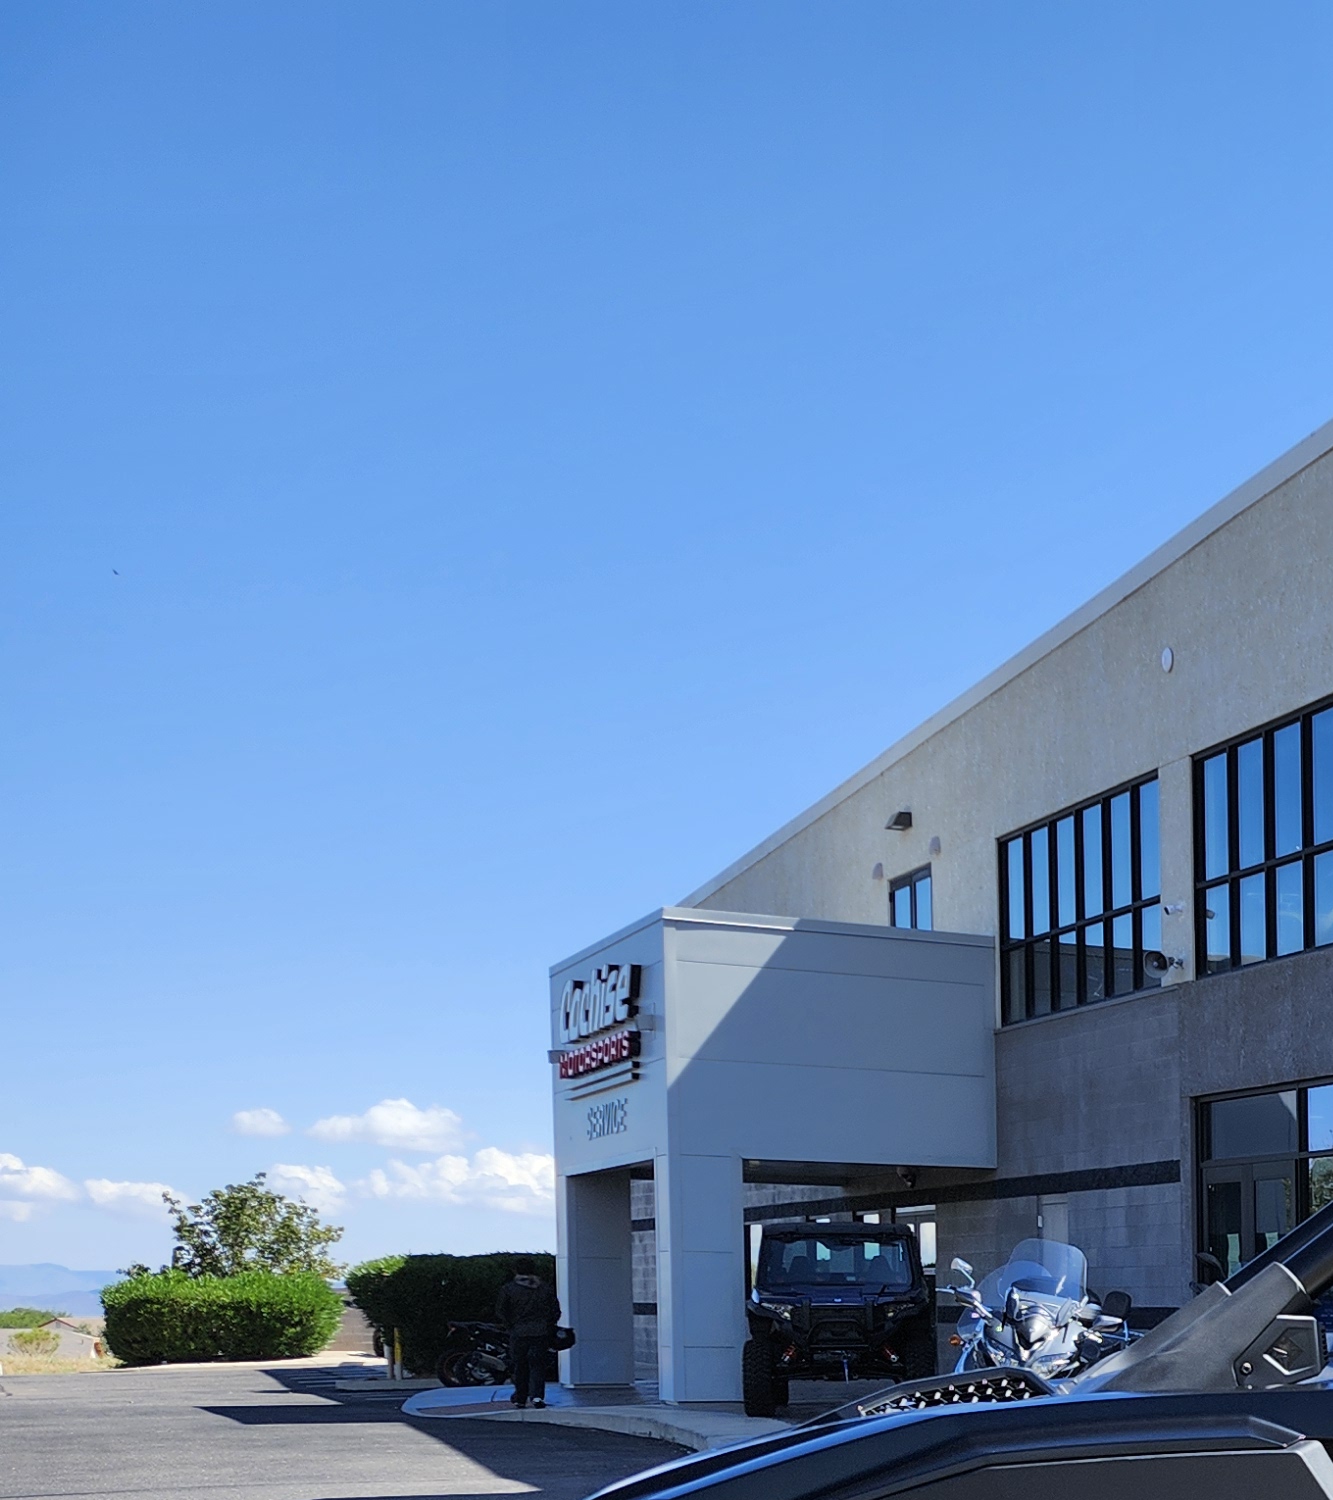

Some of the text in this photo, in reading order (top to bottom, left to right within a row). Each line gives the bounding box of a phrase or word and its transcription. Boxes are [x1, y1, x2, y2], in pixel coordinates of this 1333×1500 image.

[559, 963, 632, 1044] Cochise
[558, 1030, 632, 1080] MOTORSPORTS
[586, 1098, 629, 1142] SERVICE
